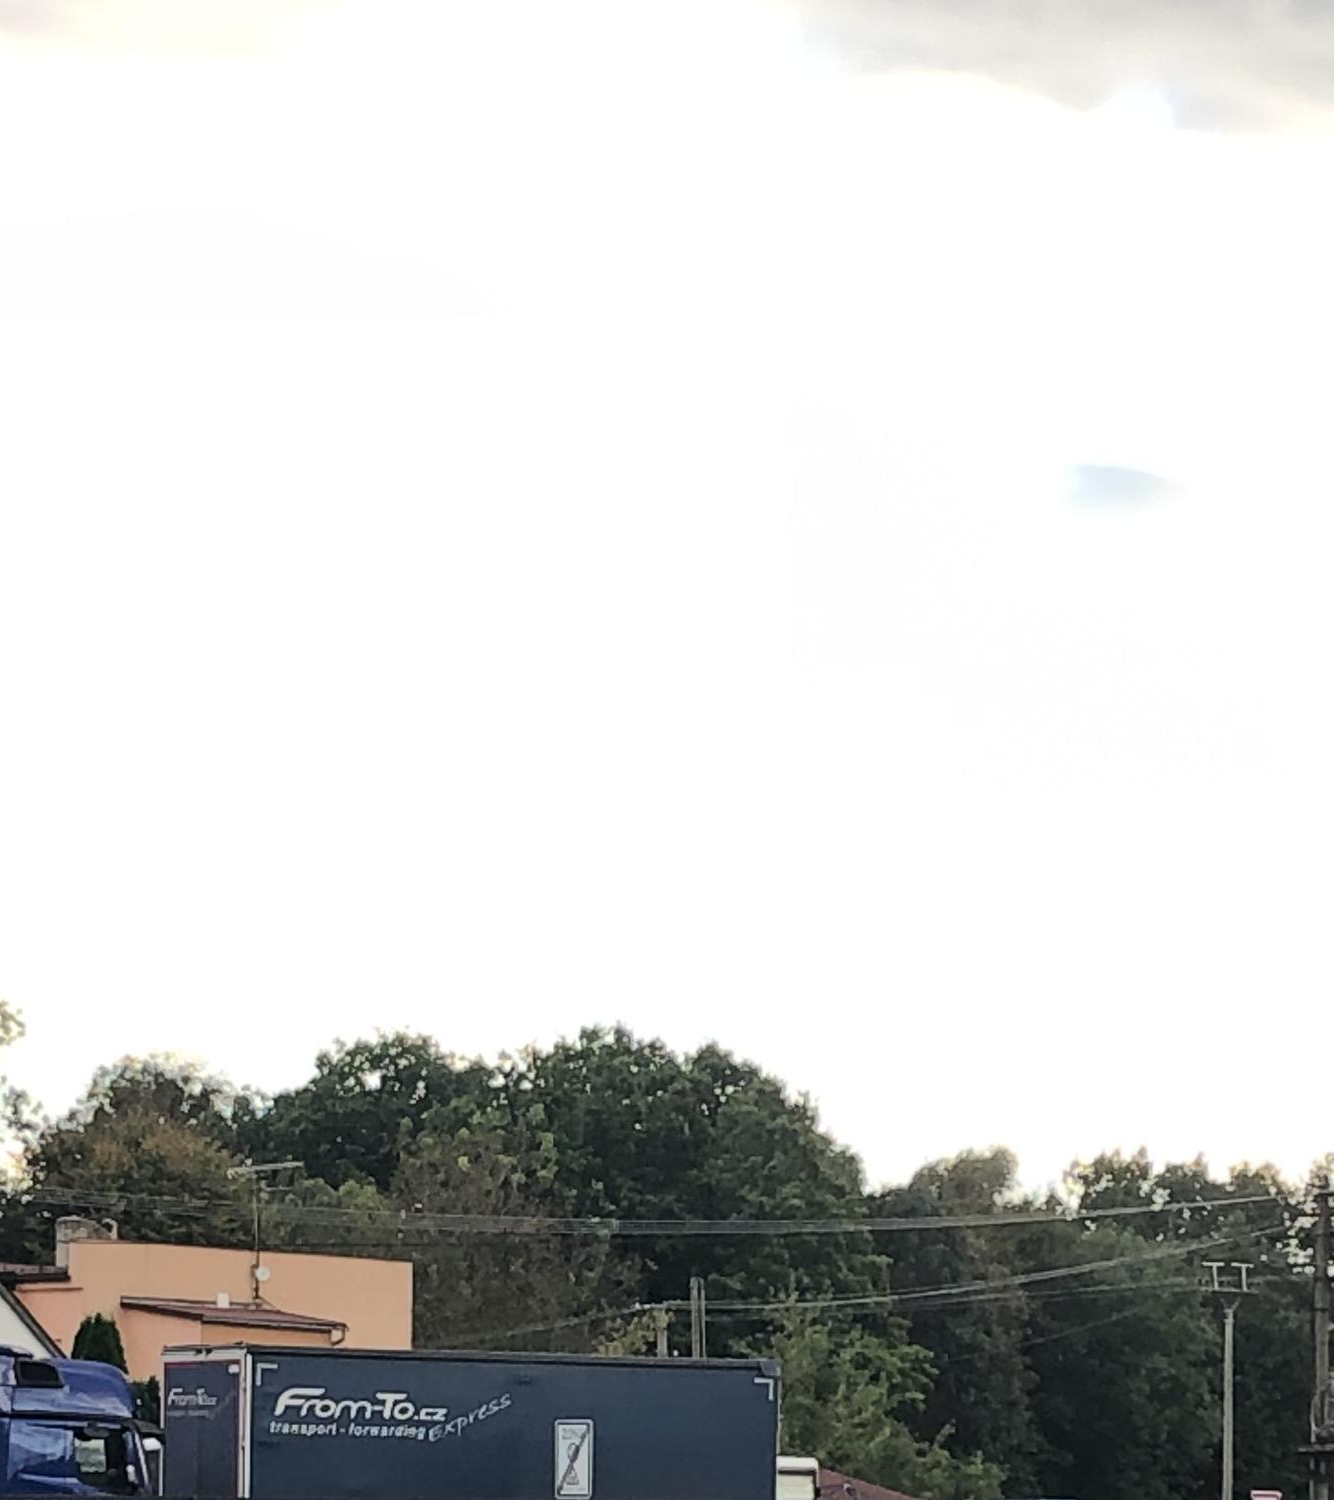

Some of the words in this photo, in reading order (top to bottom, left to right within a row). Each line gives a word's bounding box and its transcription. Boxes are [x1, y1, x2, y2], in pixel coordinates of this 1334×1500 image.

[273, 1387, 448, 1421] From-To.cz
[269, 1421, 337, 1437] transport
[348, 1423, 427, 1441] forwarding
